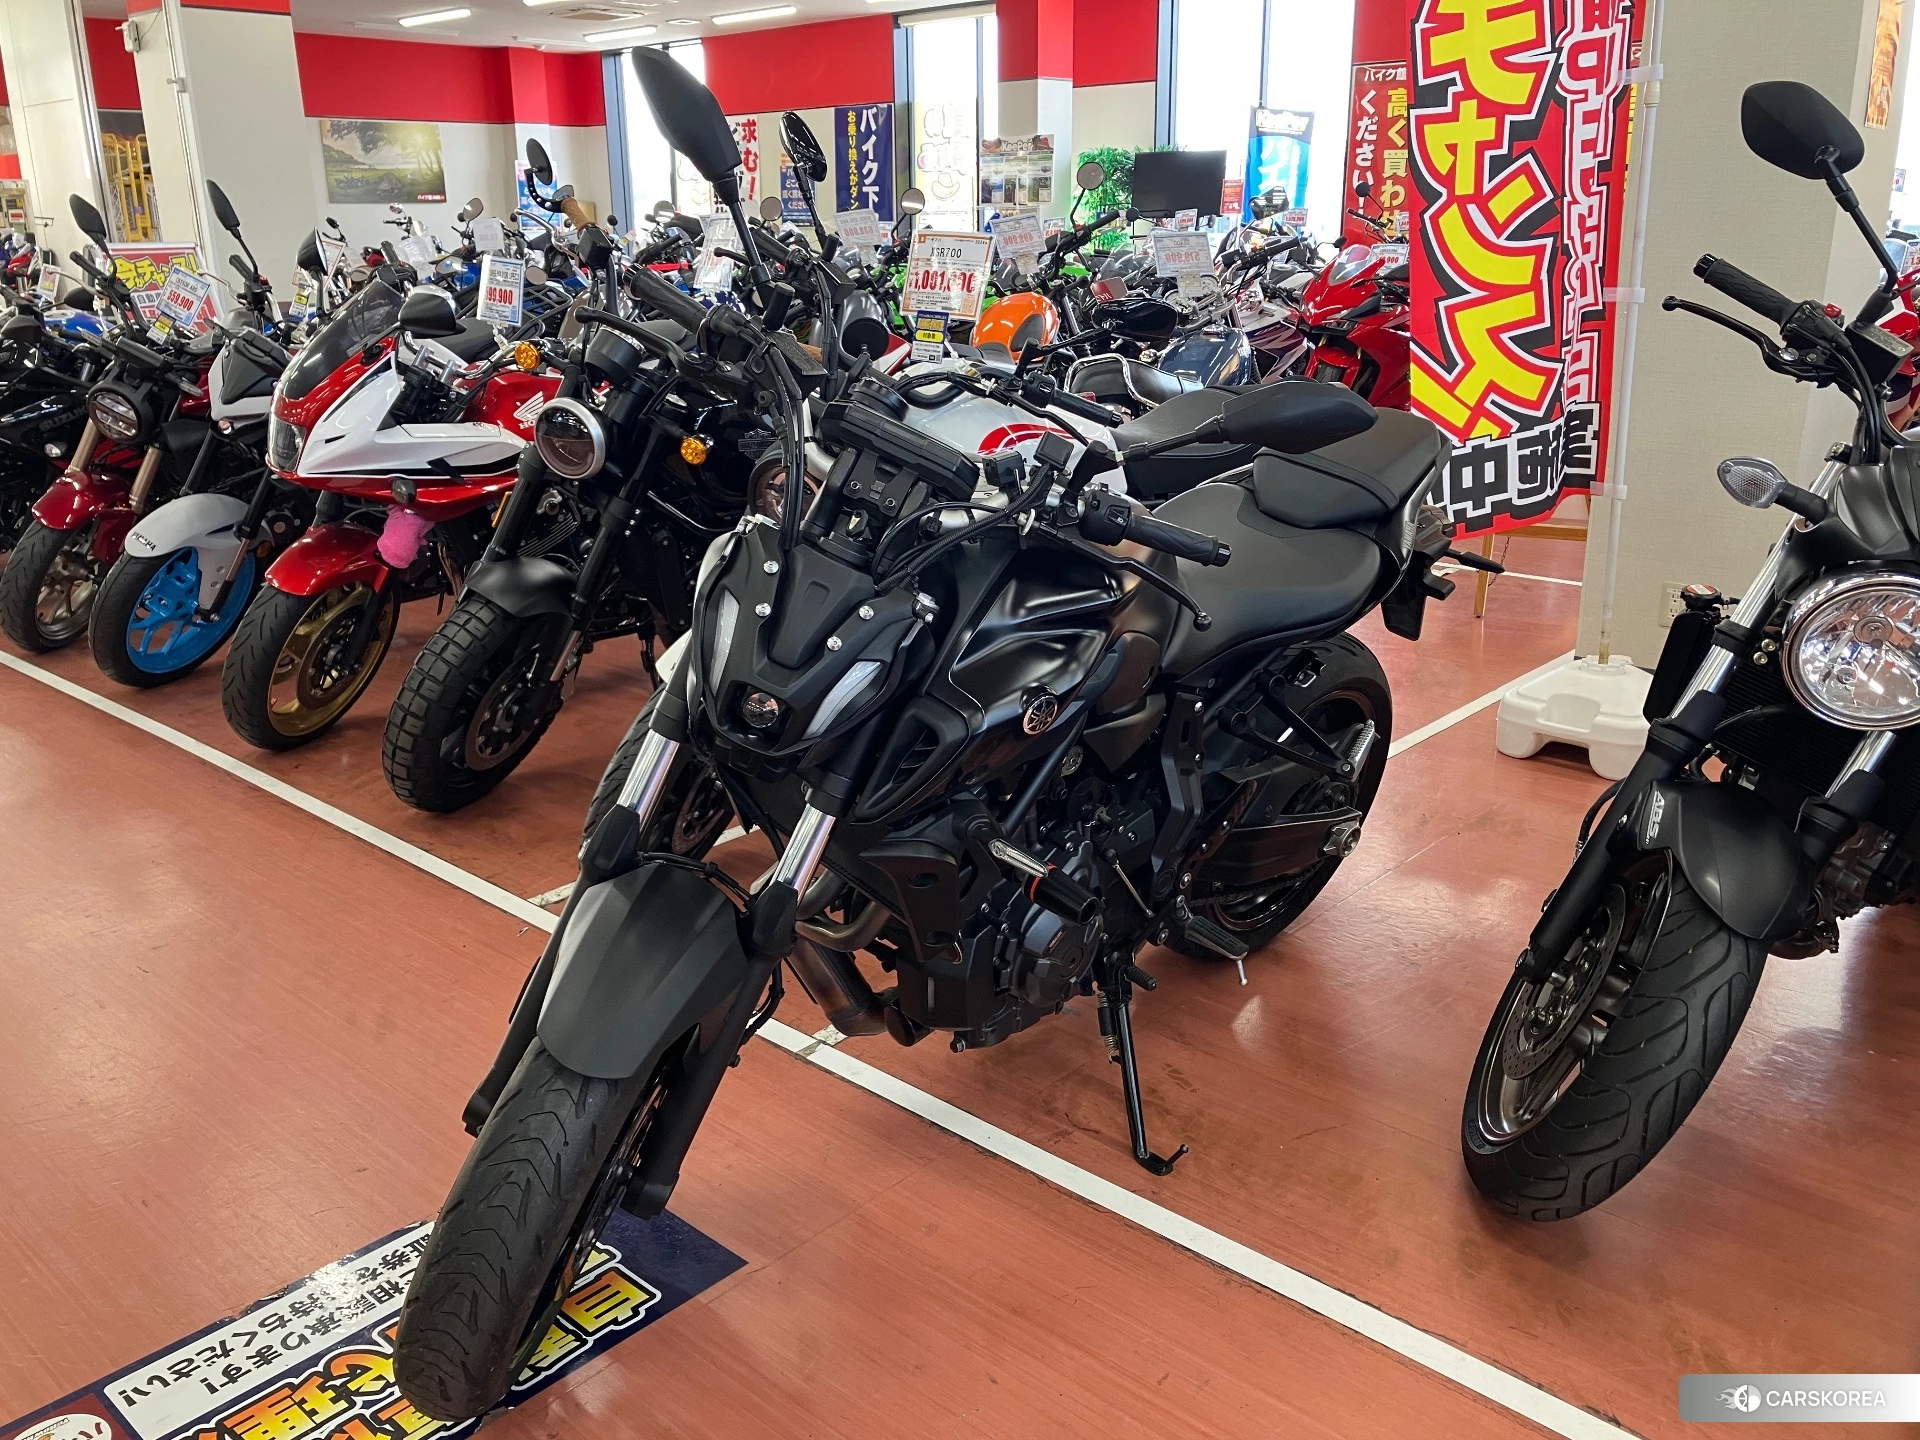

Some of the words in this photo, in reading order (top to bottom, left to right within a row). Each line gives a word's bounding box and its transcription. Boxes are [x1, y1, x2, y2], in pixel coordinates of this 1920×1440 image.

[1002, 139, 1033, 151] KeePer
[860, 106, 879, 221] バイク下
[930, 246, 962, 259] XSR700
[1402, 521, 1415, 551] YAMAHA
[1650, 790, 1665, 838] ABS
